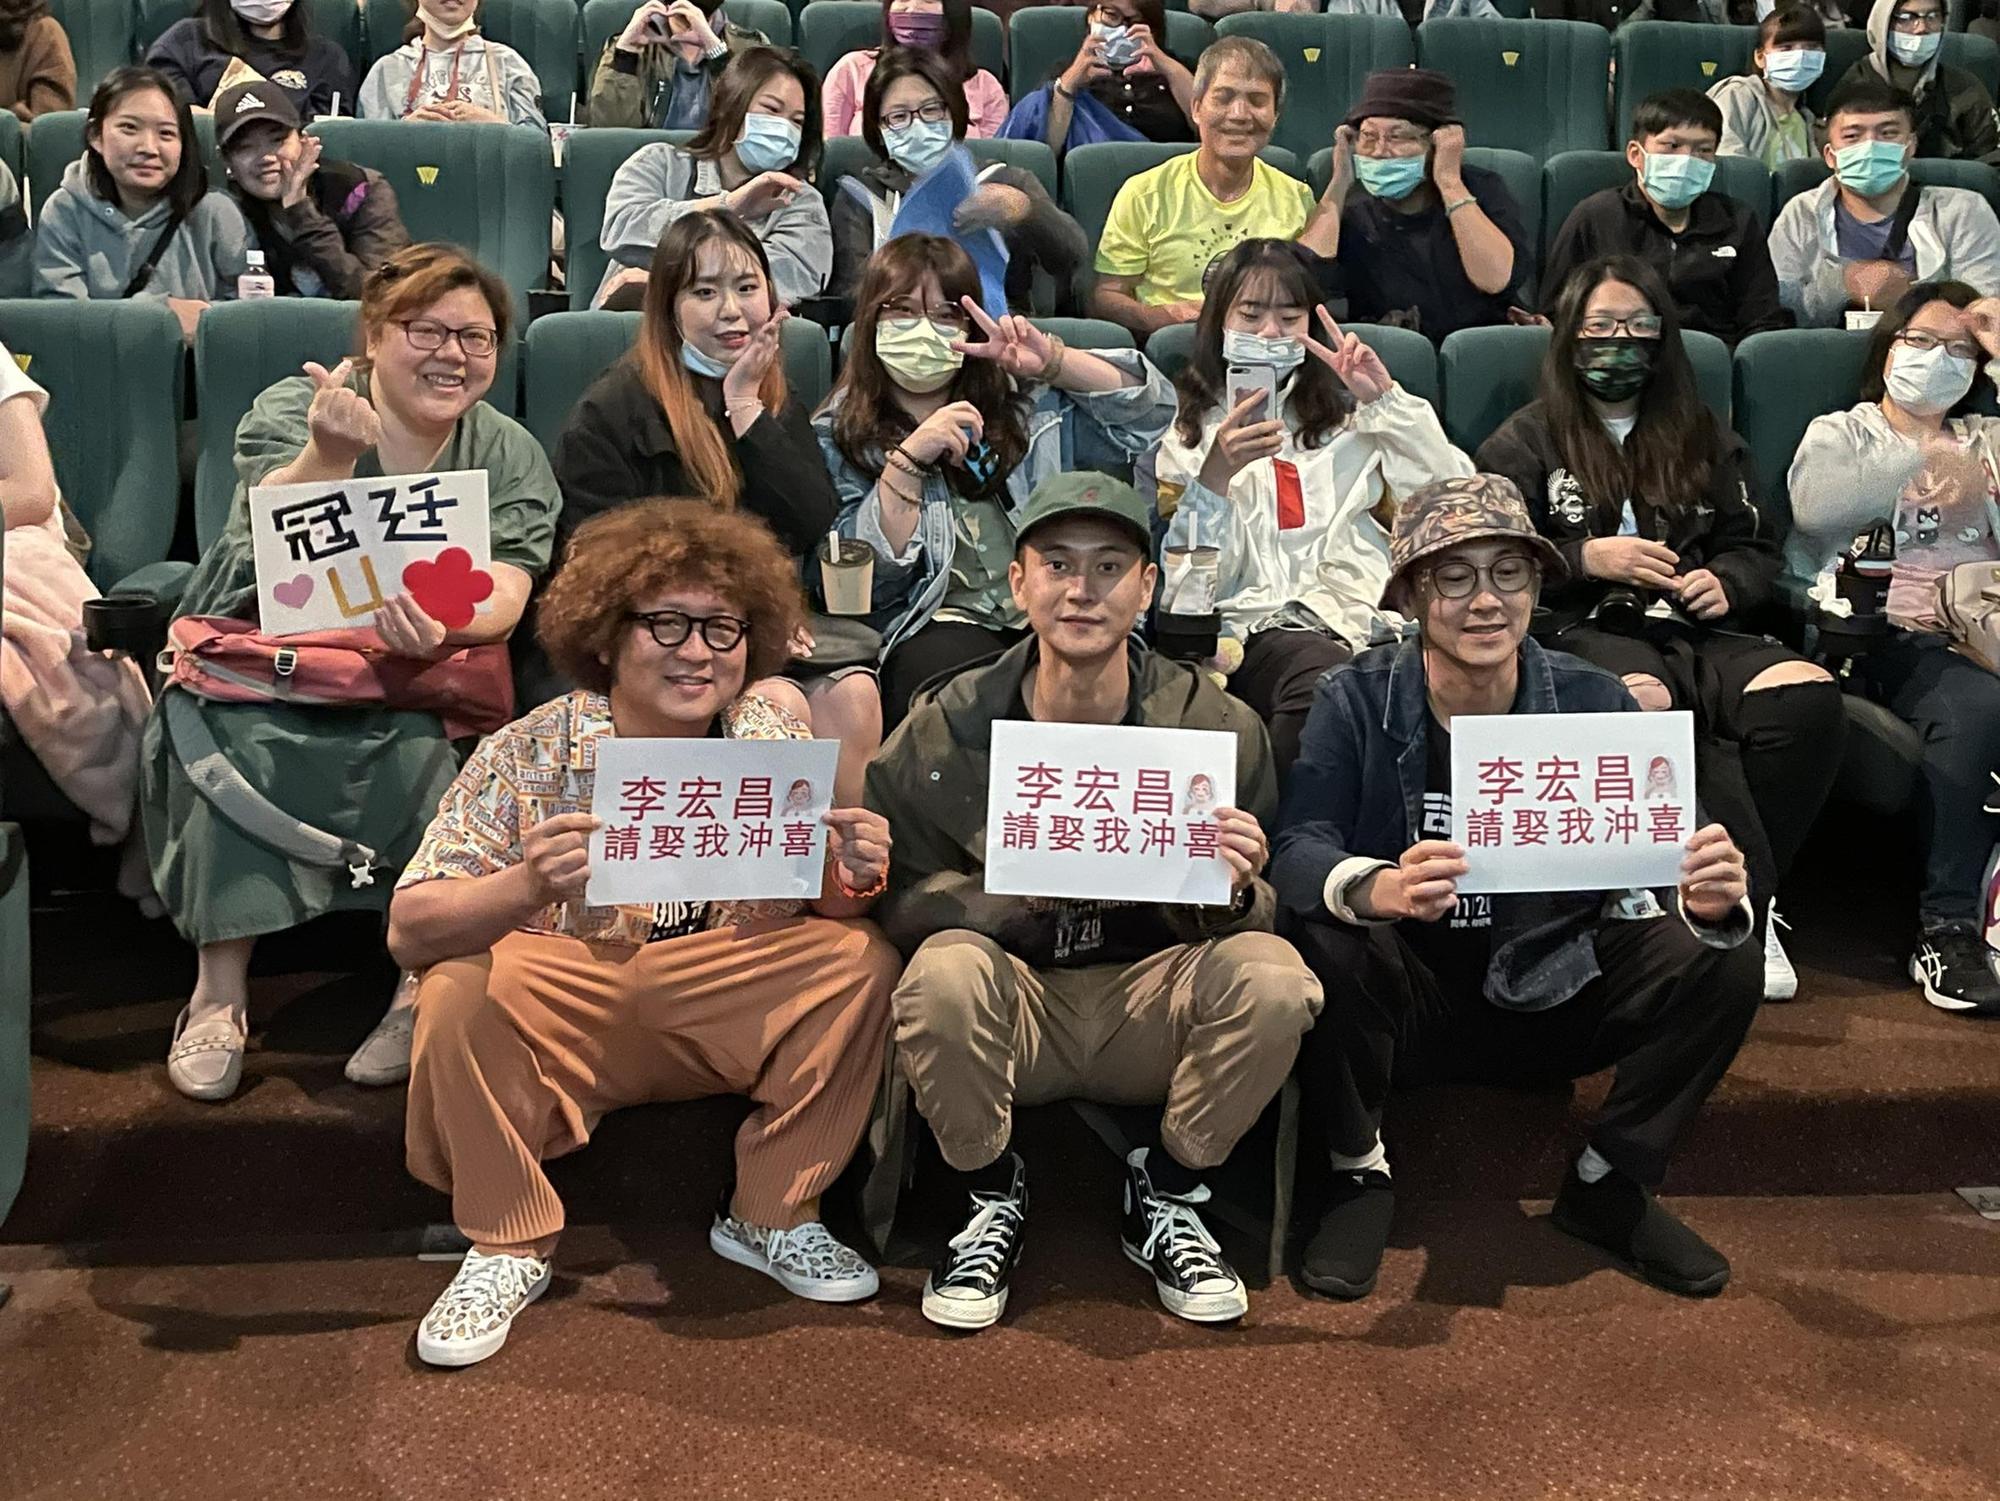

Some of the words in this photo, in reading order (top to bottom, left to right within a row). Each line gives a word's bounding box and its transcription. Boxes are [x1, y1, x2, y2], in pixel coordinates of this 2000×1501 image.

[271, 477, 458, 562] 冠廷
[618, 775, 774, 821] 李宏昌
[1016, 761, 1174, 816] 李宏昌
[1477, 754, 1635, 806] 李宏昌
[603, 820, 817, 862] 請娶我沖喜
[1002, 810, 1220, 860] 請娶我沖喜
[1466, 803, 1686, 848] 請娶我沖喜
